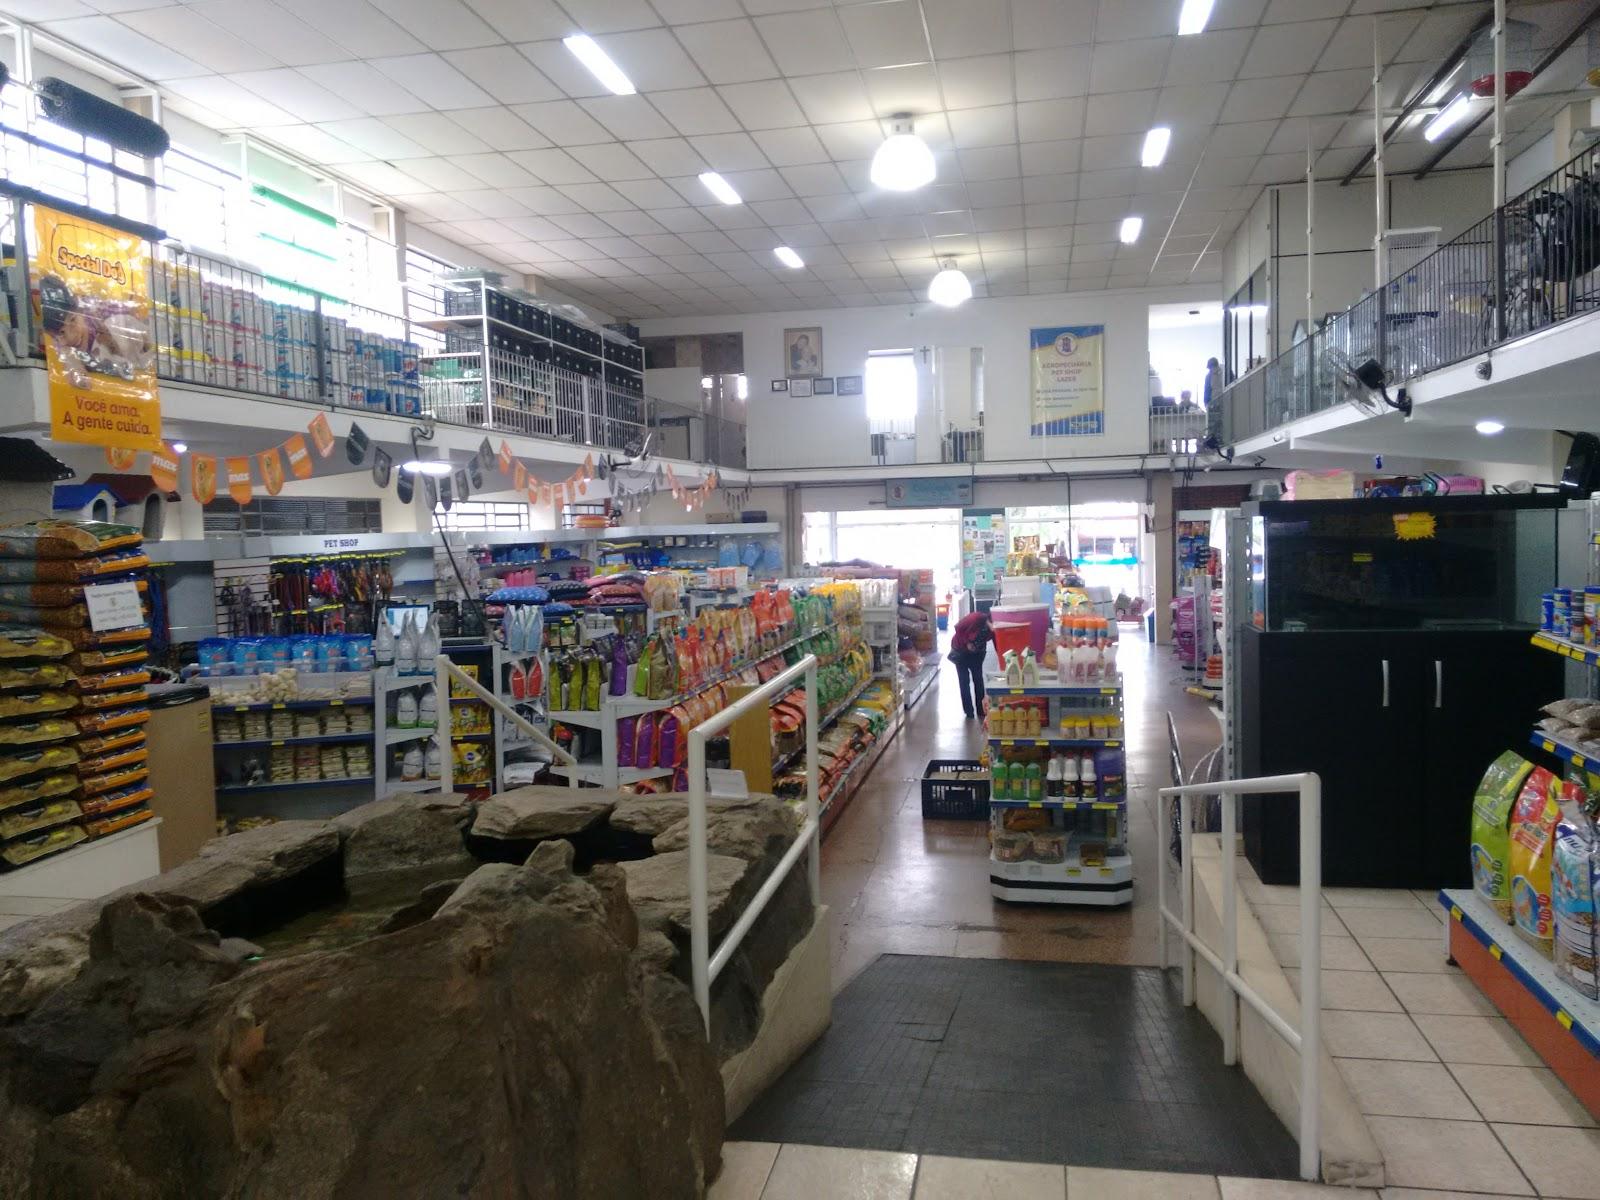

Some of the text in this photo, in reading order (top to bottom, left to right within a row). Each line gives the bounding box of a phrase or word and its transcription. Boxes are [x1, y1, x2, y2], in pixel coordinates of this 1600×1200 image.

[58, 247, 126, 285] Special Dog
[75, 395, 141, 417] Você ama.
[62, 411, 152, 435] A gente cuida.
[324, 538, 359, 548] PET SHOP
